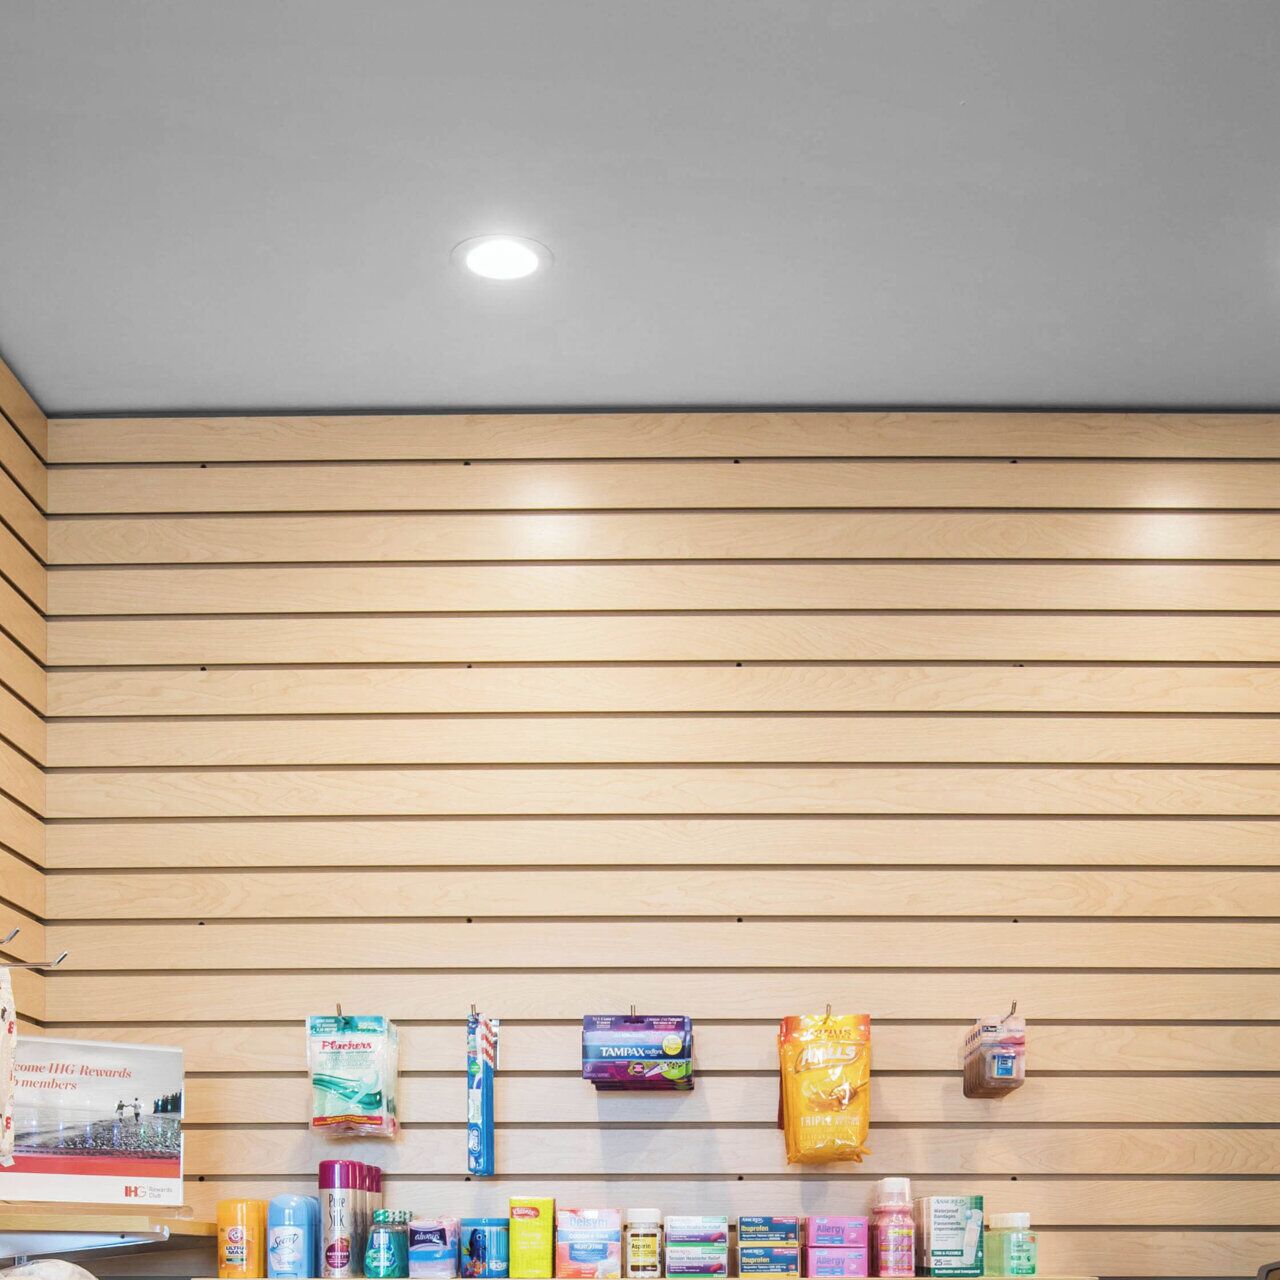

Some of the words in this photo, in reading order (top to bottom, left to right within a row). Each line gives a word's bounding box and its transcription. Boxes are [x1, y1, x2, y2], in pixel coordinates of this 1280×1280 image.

[321, 1040, 372, 1050] Plackers
[601, 1047, 645, 1057] TAMPAX
[14, 1063, 46, 1075] come
[48, 1062, 75, 1076] IHG
[79, 1065, 133, 1080] Rewards
[21, 1078, 78, 1091] members
[124, 1185, 147, 1198] IHG
[328, 1193, 346, 1209] Pure
[570, 1217, 608, 1228] Delsym
[415, 1231, 440, 1241] always
[816, 1225, 846, 1236] Allergy
[631, 1242, 652, 1250] Aspirin
[742, 1256, 770, 1264] Ibuprofen
[816, 1256, 846, 1267] Allergy
[934, 1258, 943, 1267] 25
